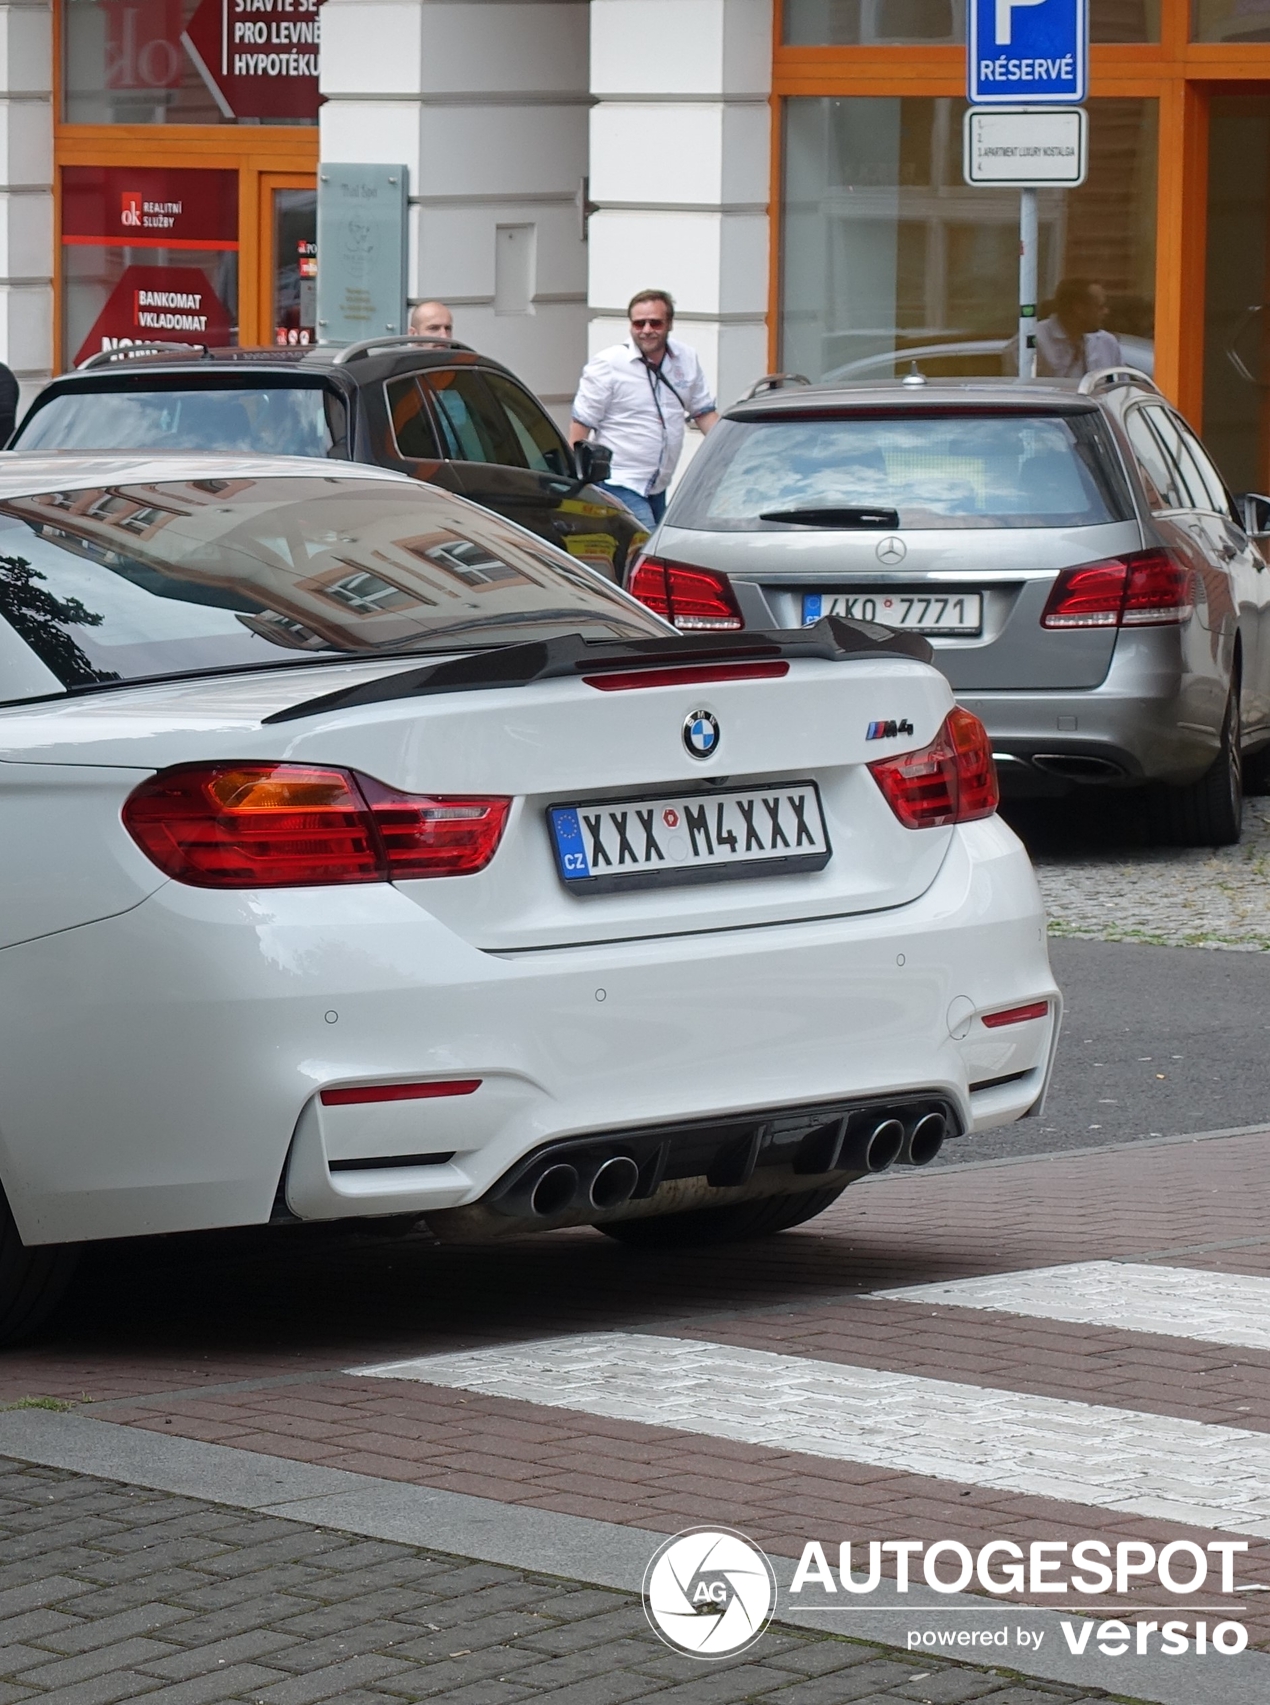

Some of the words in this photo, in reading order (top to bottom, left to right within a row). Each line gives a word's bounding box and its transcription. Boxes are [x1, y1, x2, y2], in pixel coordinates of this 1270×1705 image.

[234, 22, 267, 44] PRO
[234, 49, 320, 76] HYPOTÉKU
[980, 54, 1075, 82] RÉSERVÉ
[121, 201, 141, 226] ok
[143, 201, 182, 214] REALITNÍ
[143, 216, 174, 228] SLUŽBY
[139, 290, 201, 310] BANKOMAT
[139, 312, 207, 332] VKLADOMAT
[899, 598, 964, 624] 7771
[583, 808, 665, 867] XXX
[683, 795, 816, 857] M4XXX
[564, 852, 585, 871] CZ
